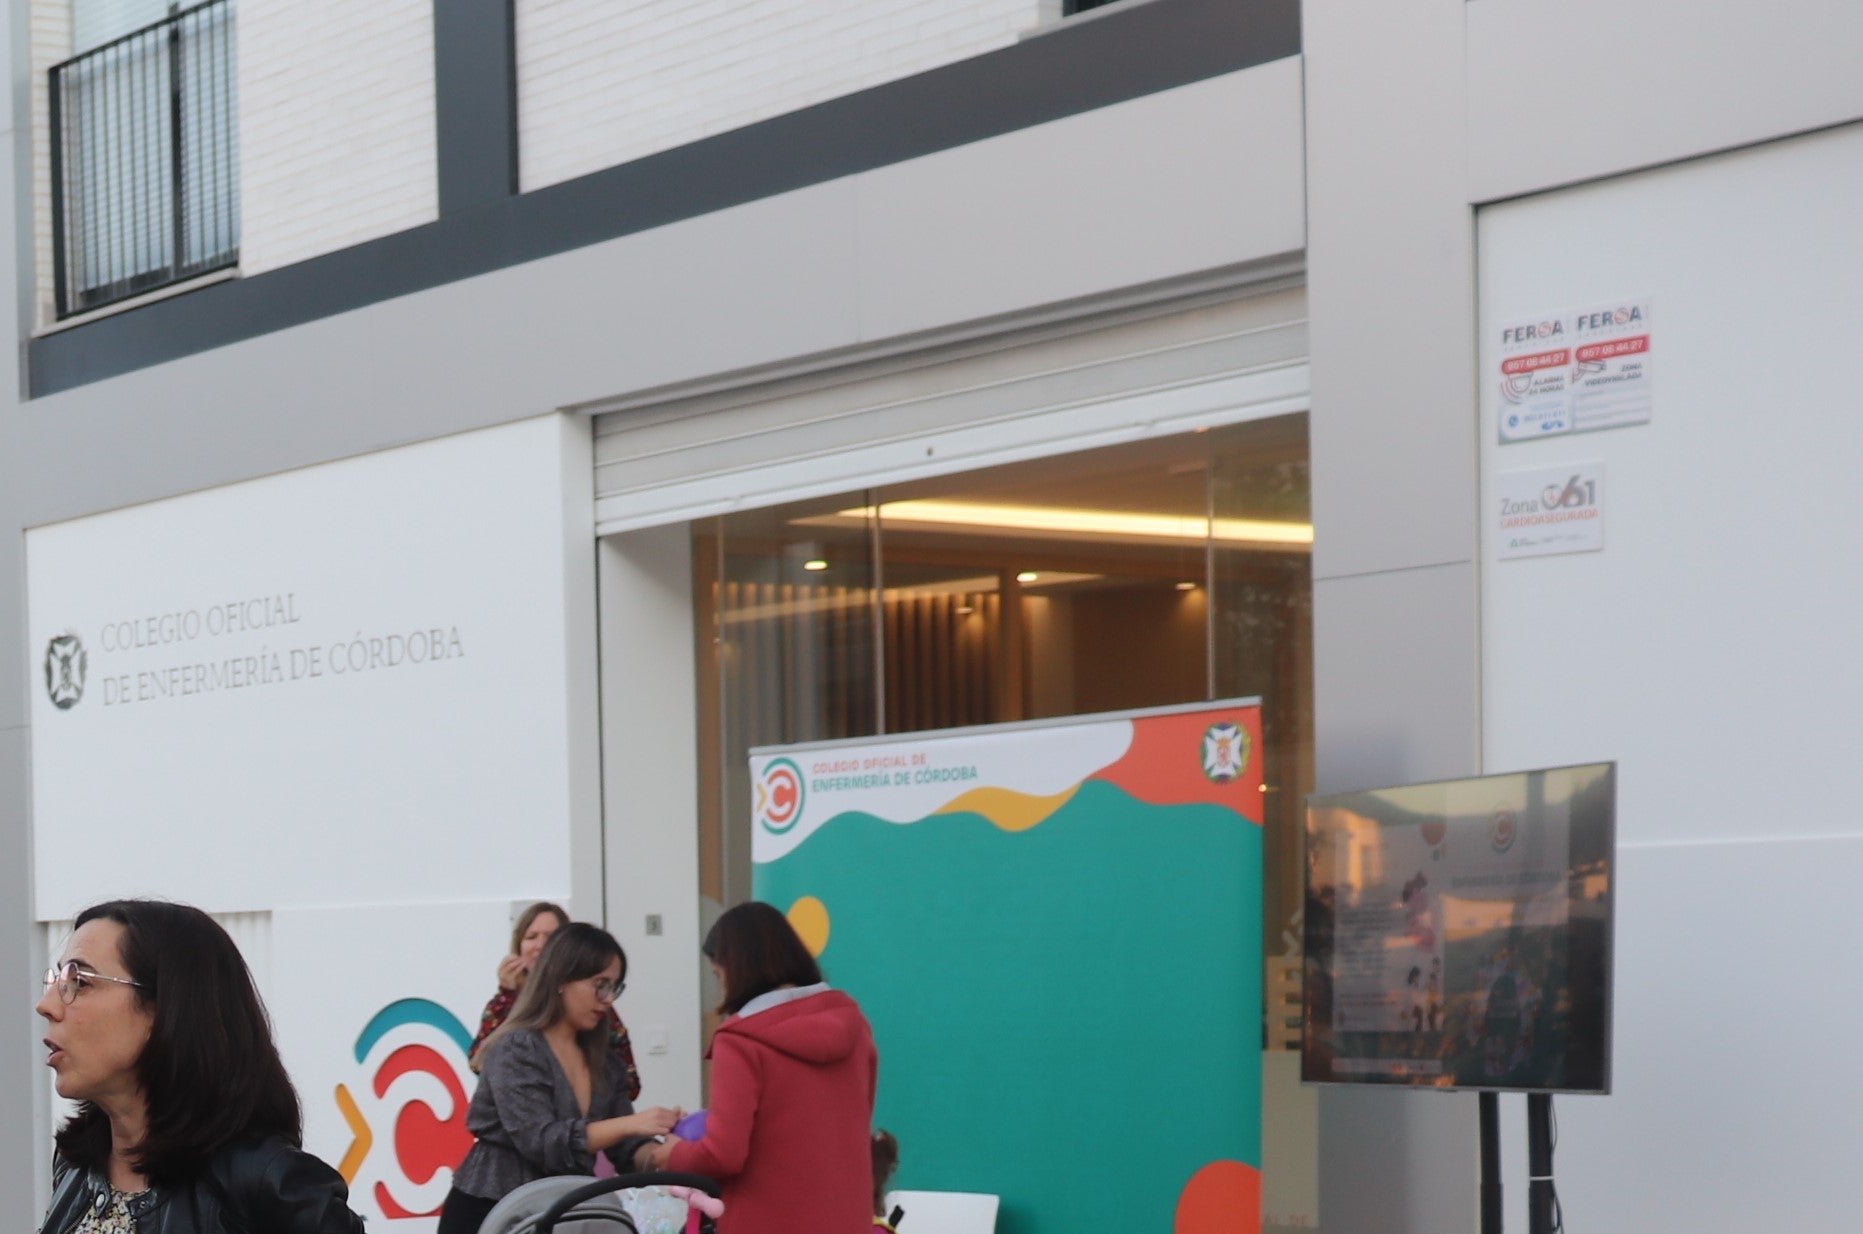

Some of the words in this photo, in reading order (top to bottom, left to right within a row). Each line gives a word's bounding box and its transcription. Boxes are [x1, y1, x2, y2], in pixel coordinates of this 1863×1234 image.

[1501, 497, 1539, 516] Zona
[100, 610, 201, 653] COLEGIO
[206, 592, 301, 638] OFICIAL
[102, 675, 131, 706] DE
[137, 646, 284, 703] ENFERMERÍA
[289, 648, 322, 682] DE
[328, 626, 465, 677] CÓRDOBA
[863, 755, 907, 770] OFICIAL
[911, 753, 928, 766] DE
[812, 769, 891, 793] ENFERMERÍA
[894, 772, 911, 786] DE
[915, 765, 978, 785] CÓRDOBA
